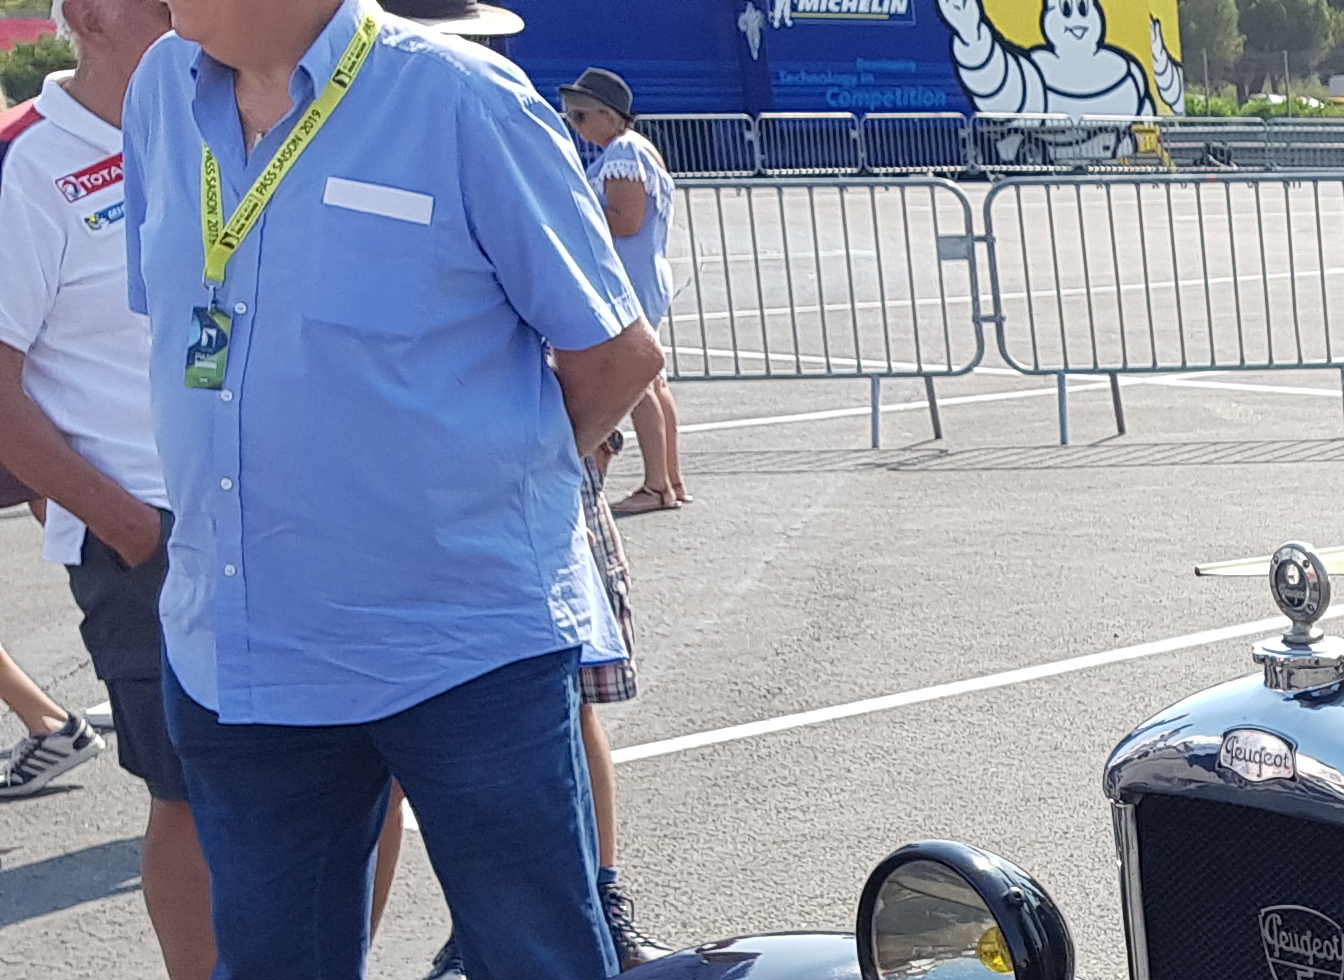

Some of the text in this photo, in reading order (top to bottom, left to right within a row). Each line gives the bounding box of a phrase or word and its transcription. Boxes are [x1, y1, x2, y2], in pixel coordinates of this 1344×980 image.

[797, 0, 908, 14] MICHELIN
[778, 69, 857, 87] Technology
[825, 86, 947, 110] Competition
[256, 109, 321, 196] PASS SAISON 2019
[78, 164, 124, 190] TOTA
[1225, 735, 1291, 778] Peugeot
[1264, 912, 1343, 966] Peugeot
